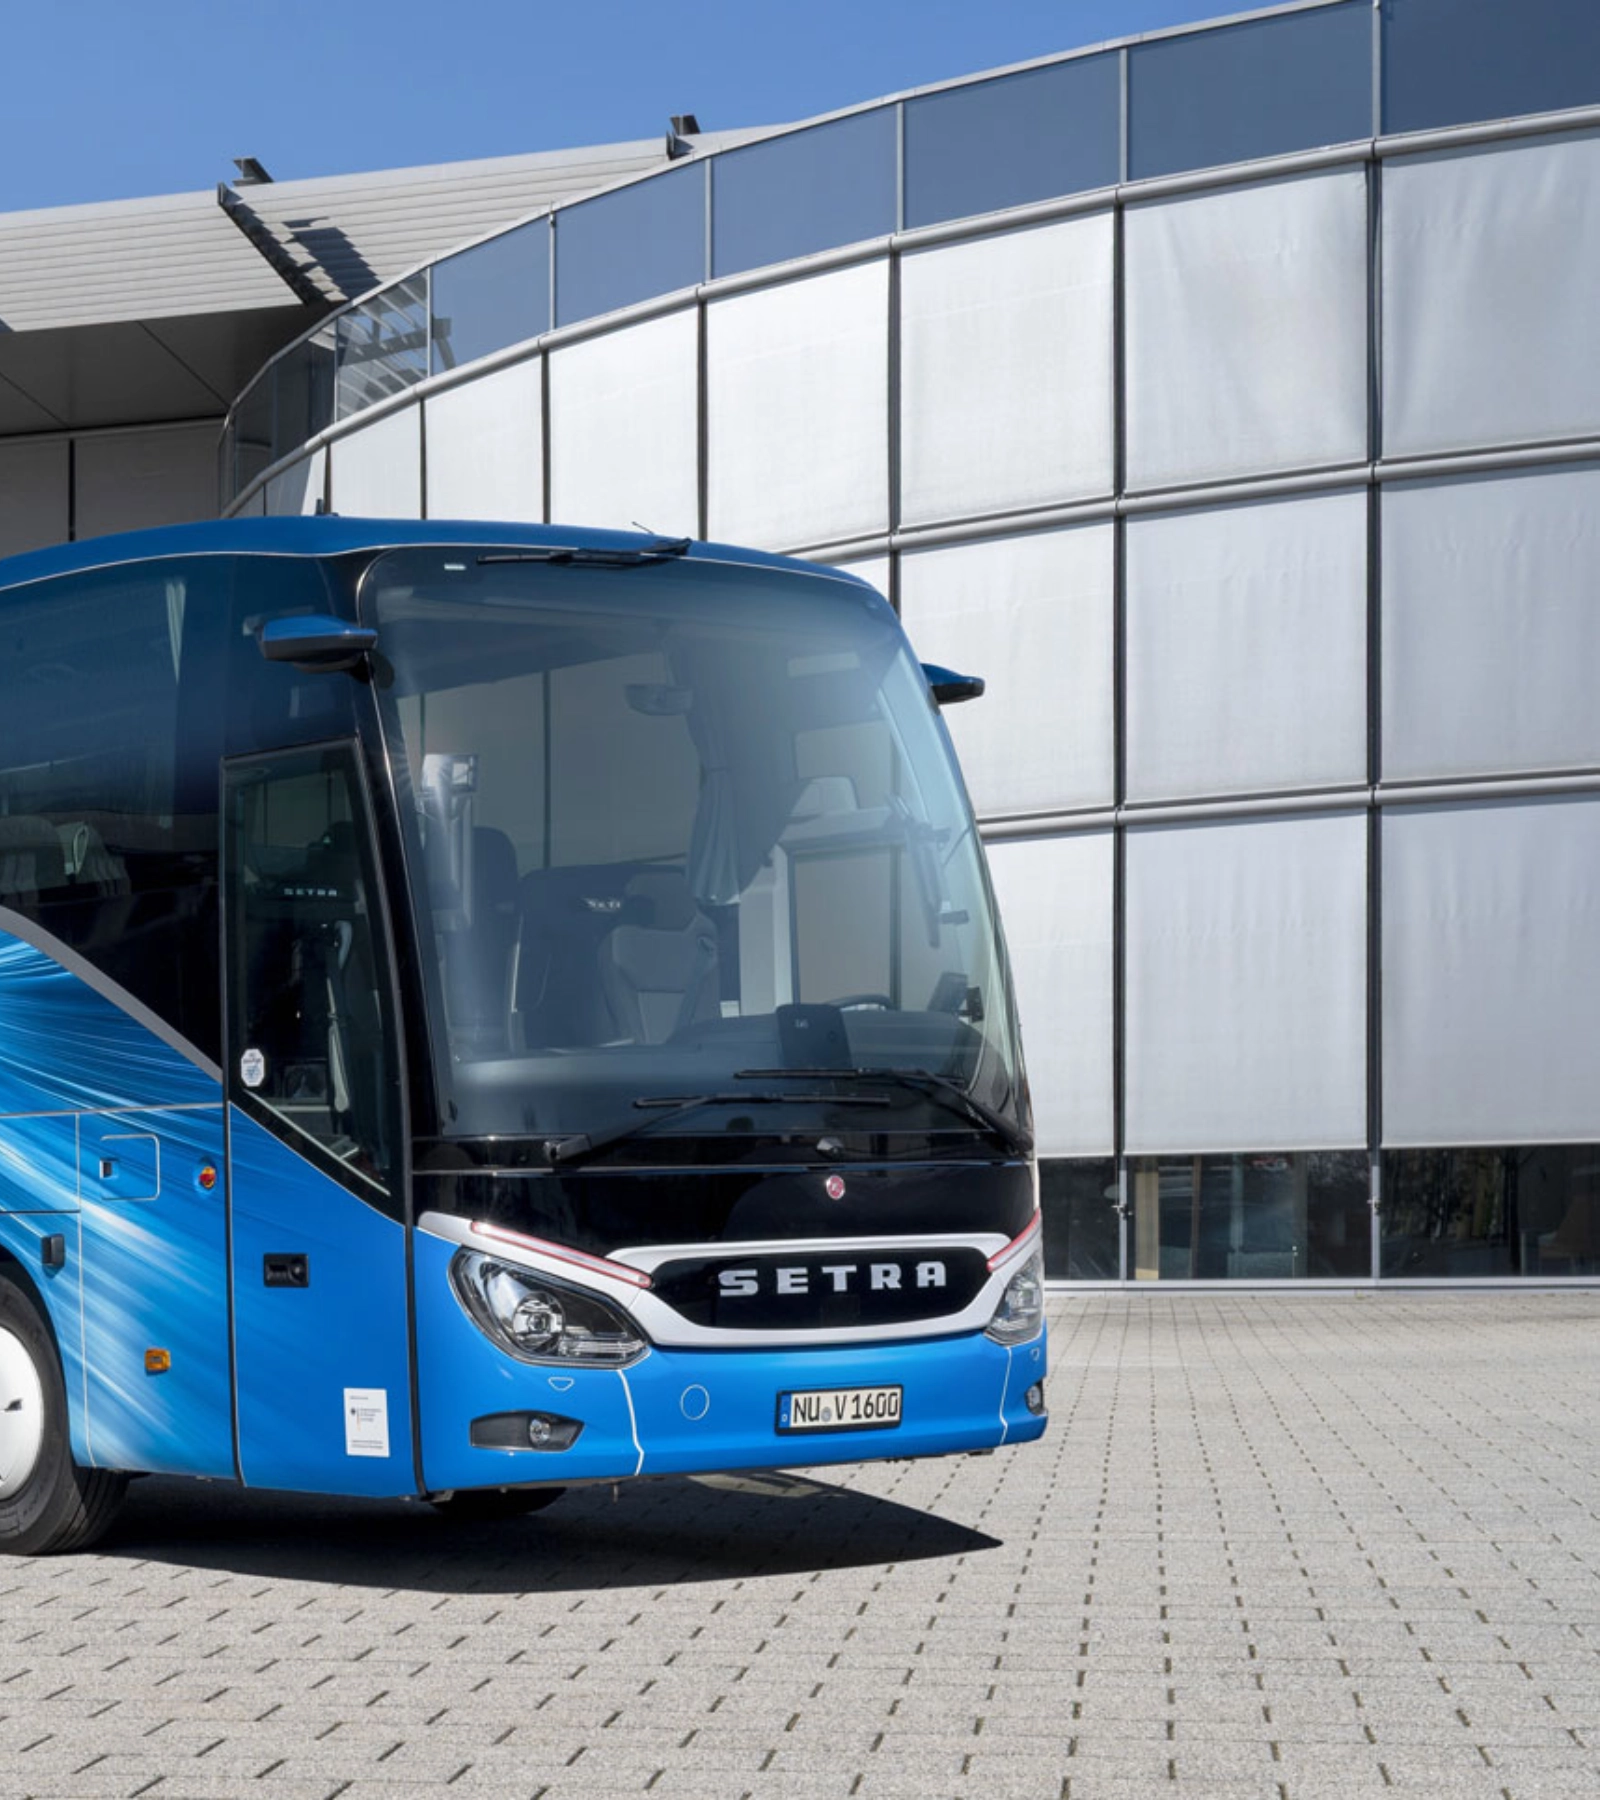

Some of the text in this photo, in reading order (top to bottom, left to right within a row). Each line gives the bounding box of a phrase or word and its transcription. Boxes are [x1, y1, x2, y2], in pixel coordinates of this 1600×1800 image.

[718, 1261, 947, 1297] SETRA
[793, 1396, 821, 1424] NU
[834, 1395, 847, 1420] V
[851, 1392, 898, 1420] 1600
